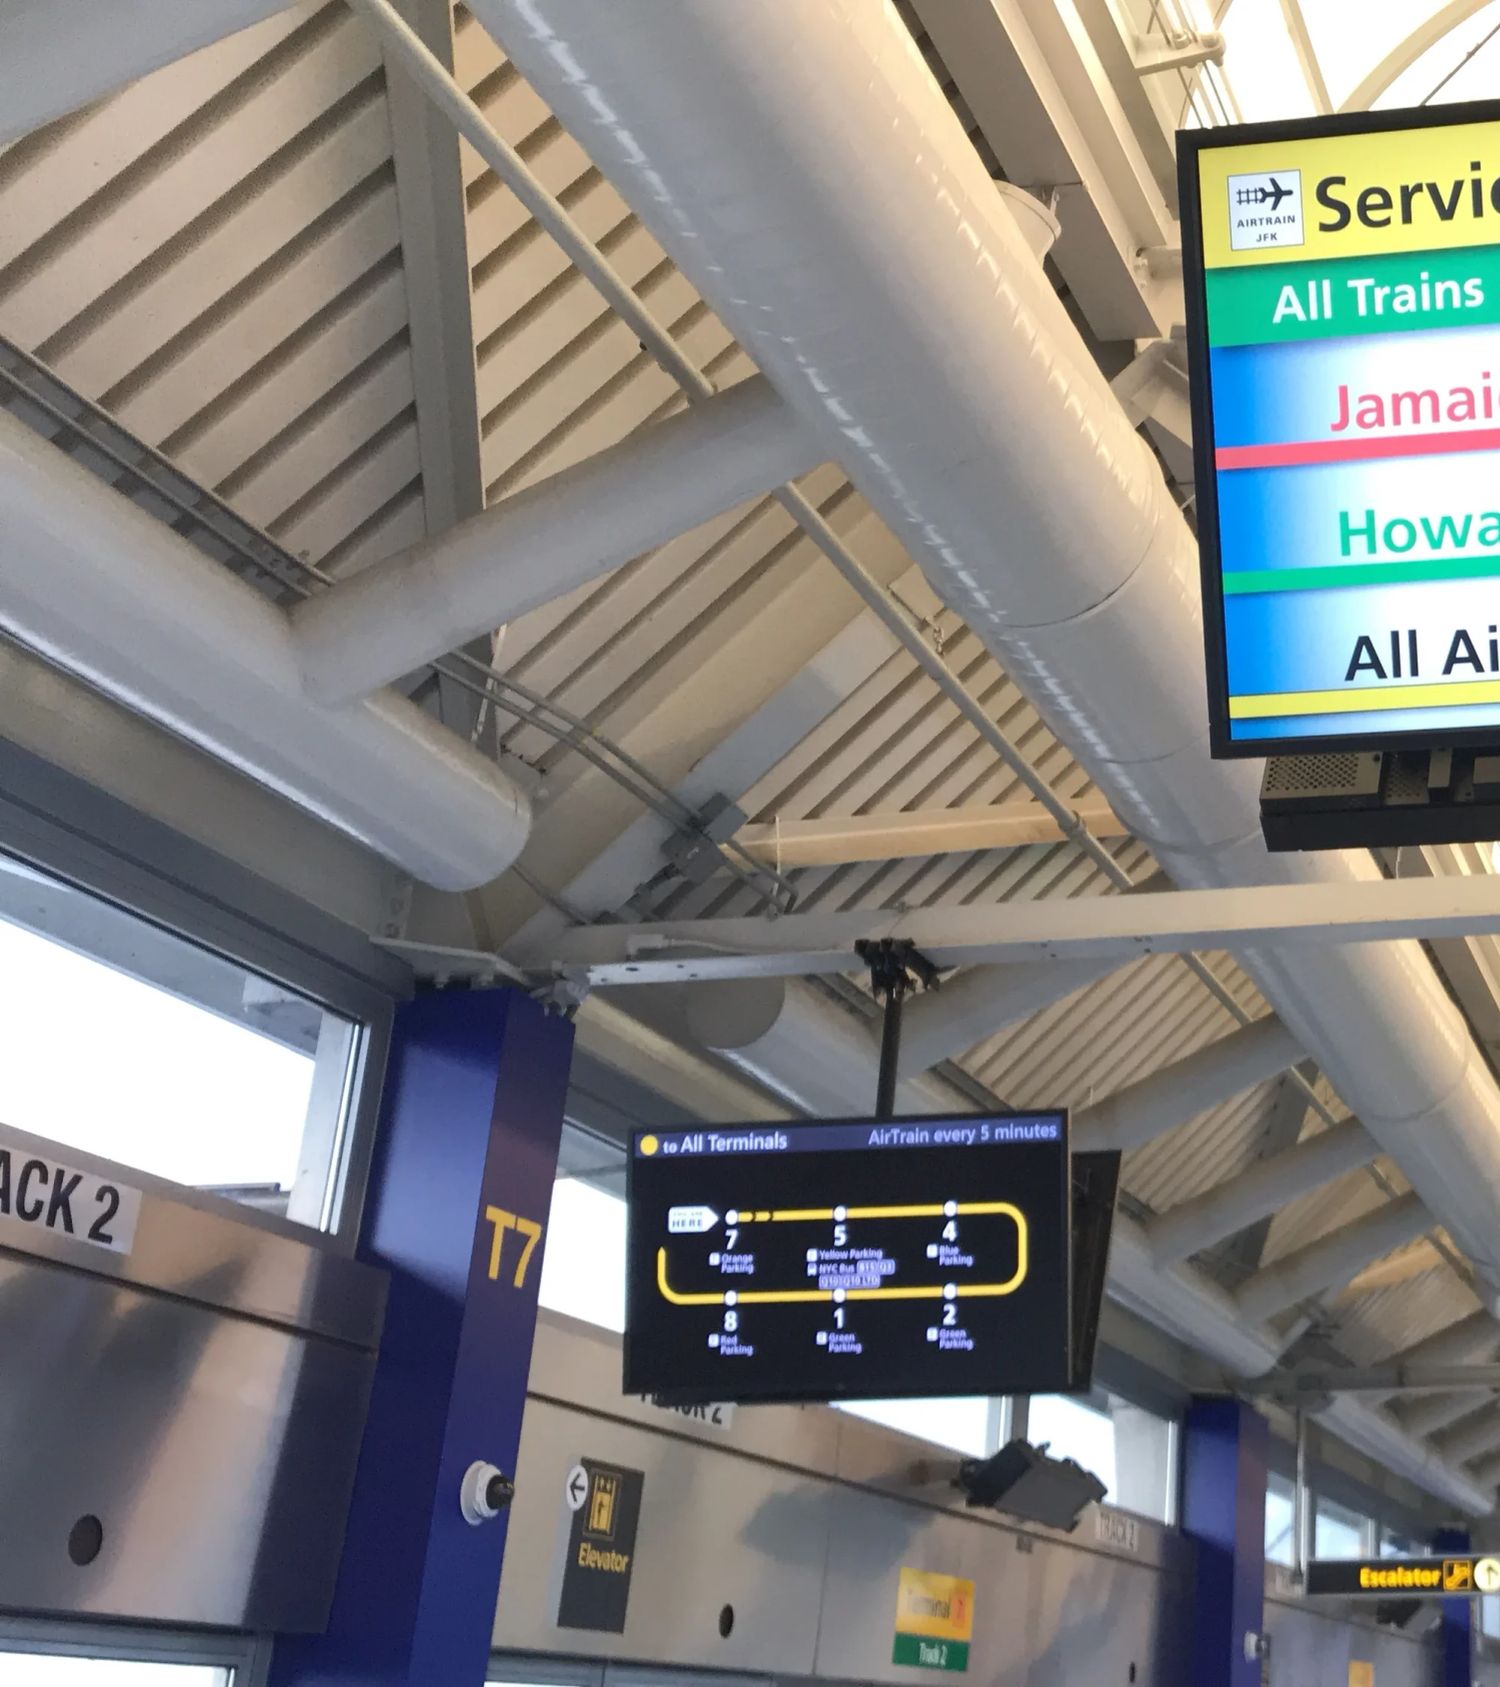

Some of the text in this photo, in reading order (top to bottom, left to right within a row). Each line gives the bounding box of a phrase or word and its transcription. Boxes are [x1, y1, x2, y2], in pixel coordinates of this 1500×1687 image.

[1237, 215, 1296, 228] AIRTRAIN
[1256, 232, 1278, 243] JFK
[1272, 280, 1333, 325] All
[1347, 272, 1484, 318] Trains
[1345, 630, 1419, 682] All
[663, 1131, 788, 1154] to All Terminals
[868, 1123, 1058, 1146] AirTrain every 5 minutes
[88, 1185, 120, 1244] 2
[725, 1229, 739, 1250] 7
[833, 1224, 848, 1247] 5
[942, 1220, 957, 1242] 4
[484, 1204, 542, 1289] T7
[820, 1248, 883, 1260] Yellow Parking
[939, 1245, 960, 1256] Blue
[721, 1253, 754, 1265] Orange
[939, 1255, 974, 1268] Parking
[721, 1262, 755, 1275] Parking
[819, 1263, 839, 1274] NYC
[839, 1262, 856, 1273] Bus
[724, 1310, 738, 1332] 8
[833, 1307, 845, 1329] 1
[943, 1303, 957, 1326] 2
[720, 1335, 738, 1346] Red
[828, 1332, 855, 1343] Green
[939, 1329, 967, 1339] Green
[720, 1344, 753, 1357] Parking
[828, 1342, 862, 1355] Parking
[939, 1338, 974, 1351] Parking
[578, 1542, 630, 1574] Elevator
[1359, 1566, 1442, 1588] Escalator
